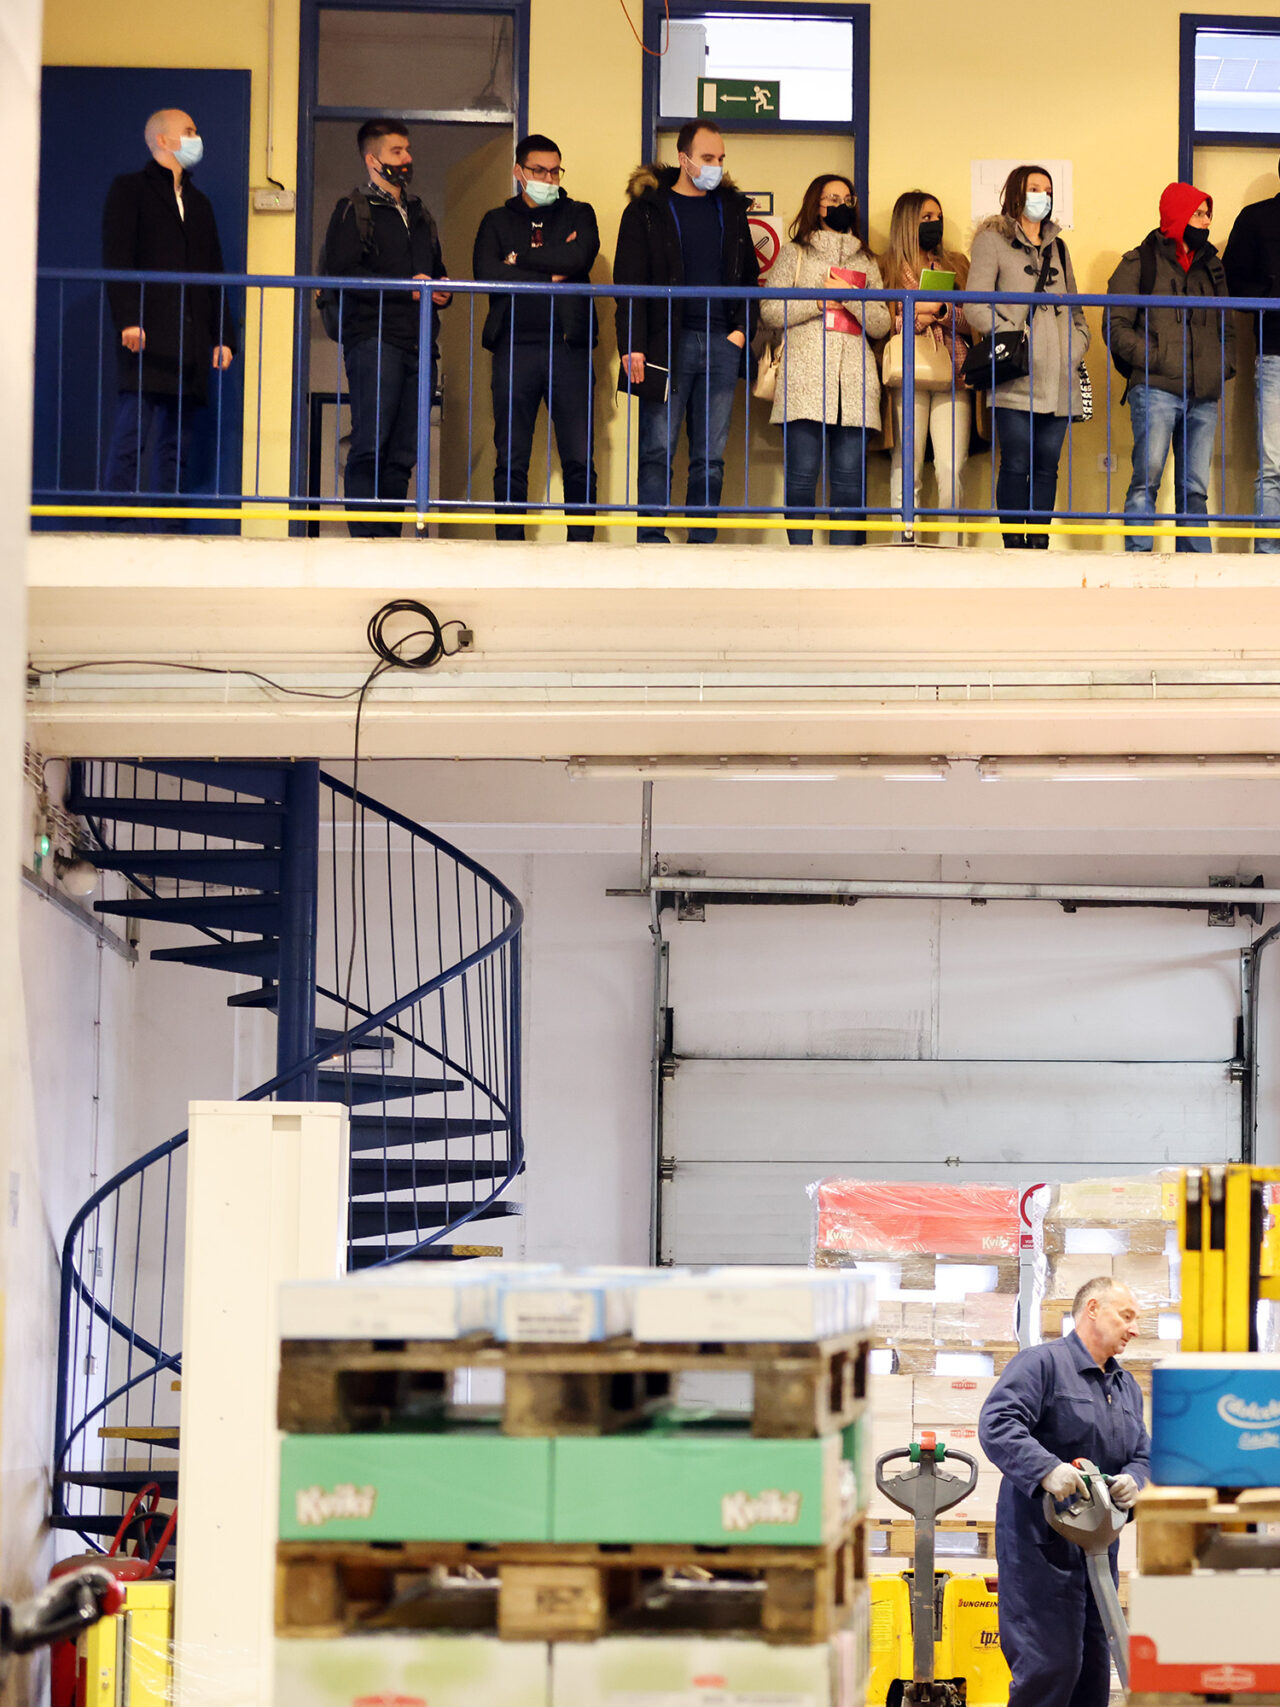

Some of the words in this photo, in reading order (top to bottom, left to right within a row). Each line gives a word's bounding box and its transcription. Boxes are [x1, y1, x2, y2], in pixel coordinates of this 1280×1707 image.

[296, 1484, 377, 1526] Kviki
[722, 1488, 802, 1531] Kviki
[980, 1630, 999, 1646] tpz
